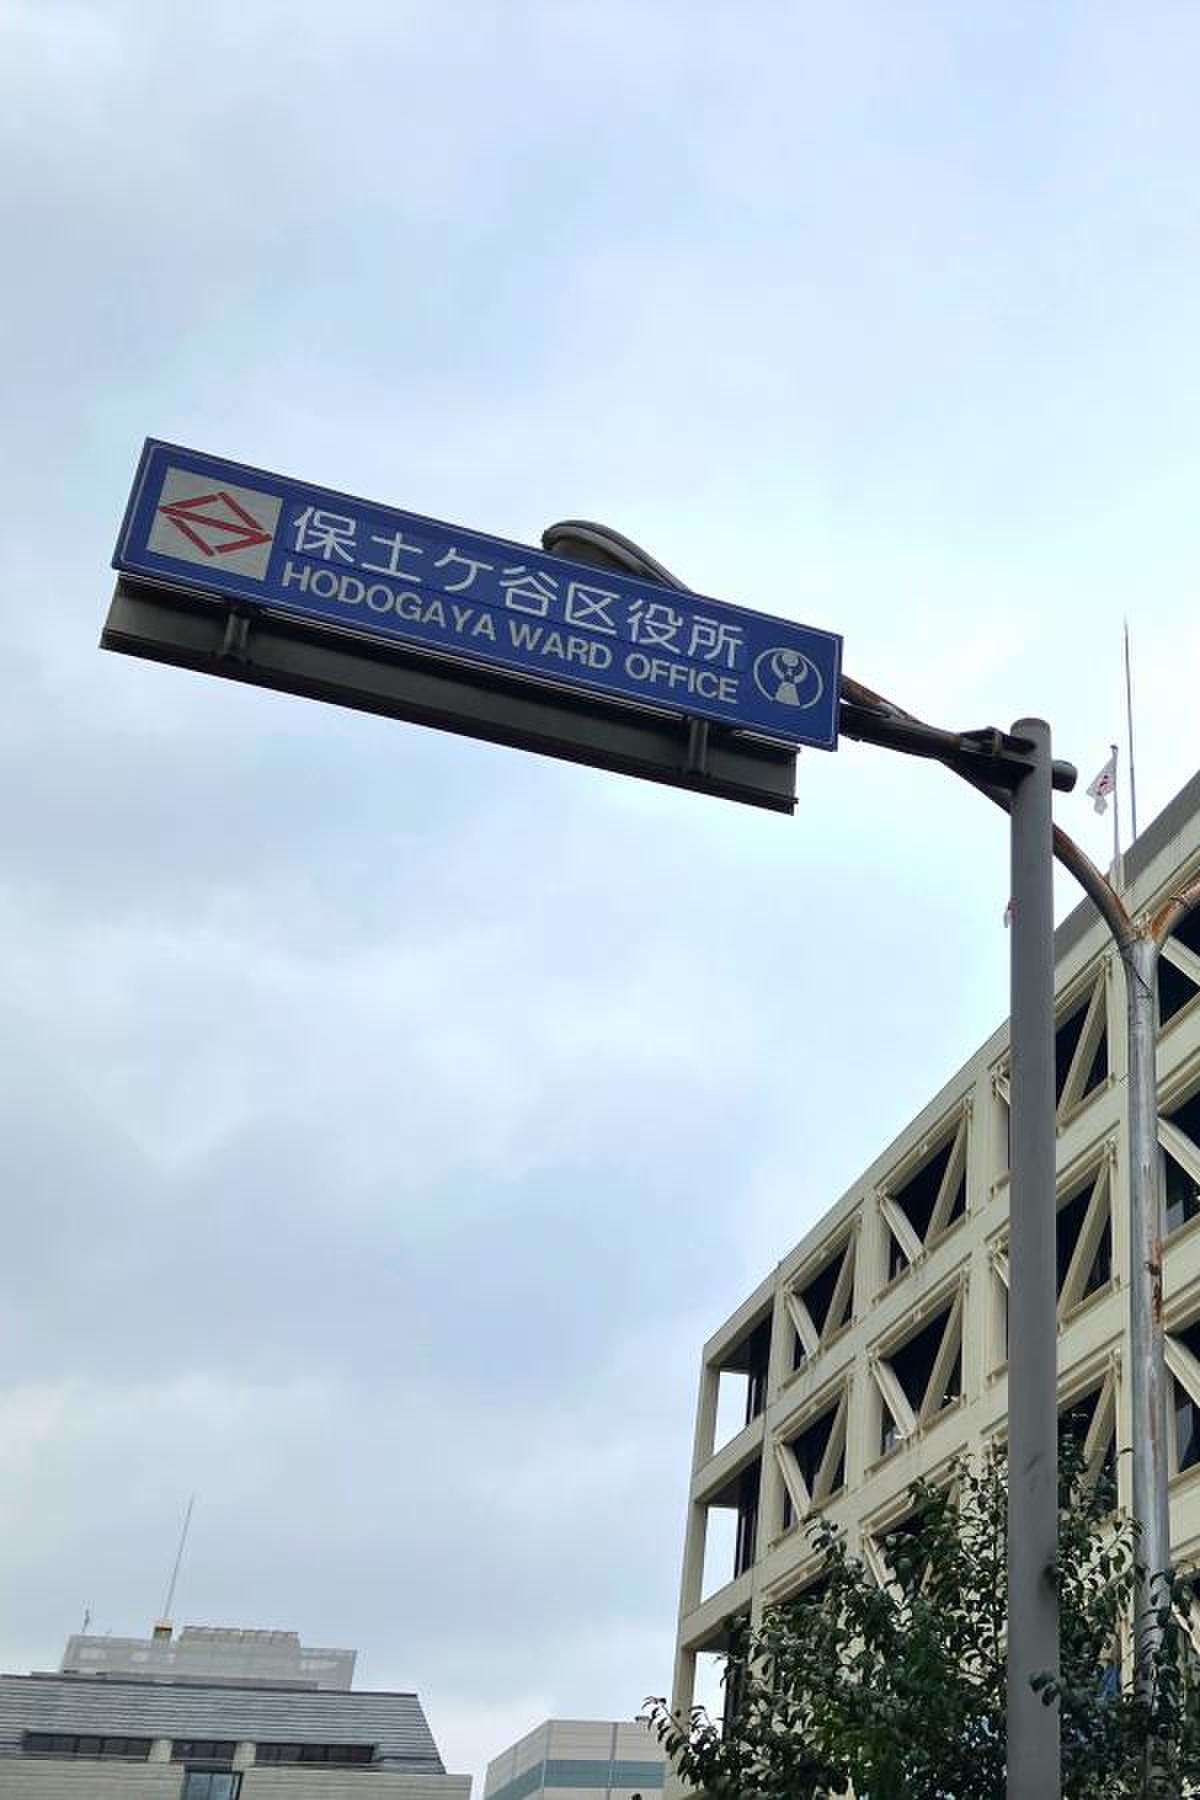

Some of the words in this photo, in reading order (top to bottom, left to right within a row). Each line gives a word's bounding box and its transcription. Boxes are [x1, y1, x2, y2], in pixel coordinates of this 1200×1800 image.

[281, 561, 497, 641] HODOGAYA
[510, 622, 613, 670] WARD
[626, 652, 739, 704] OFFICE
[293, 506, 743, 669] 保土ケ谷区役所
